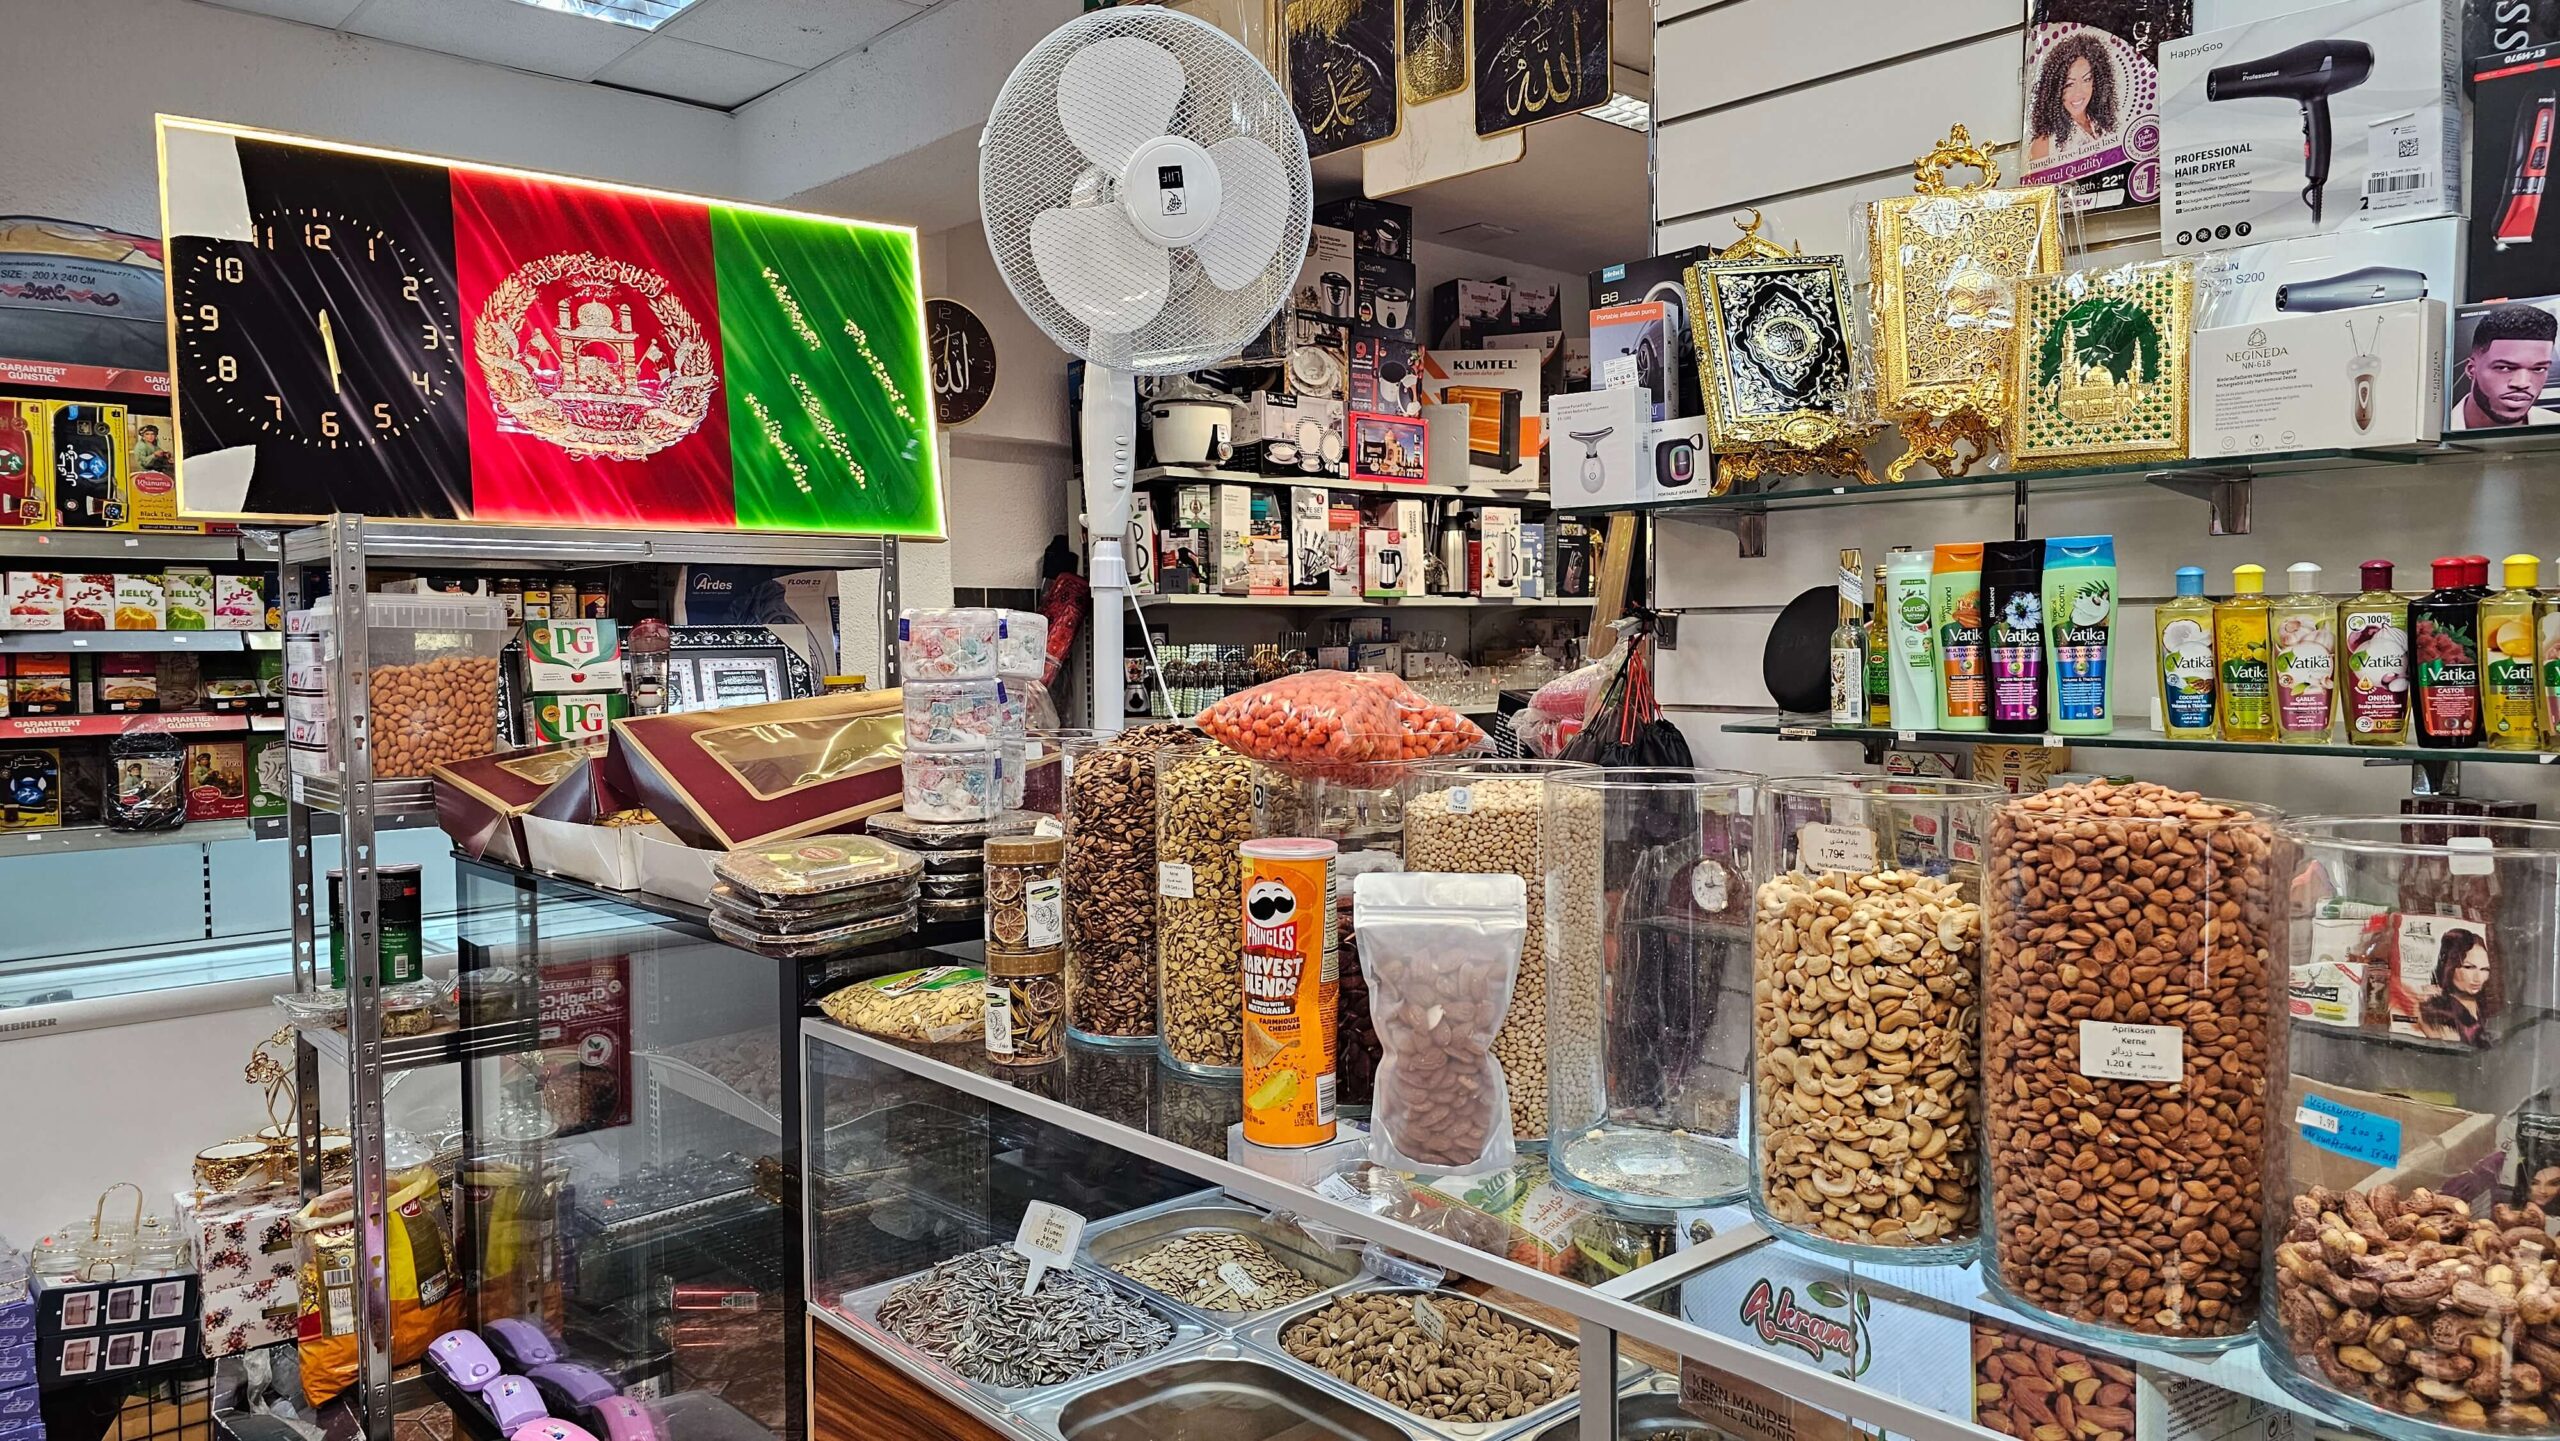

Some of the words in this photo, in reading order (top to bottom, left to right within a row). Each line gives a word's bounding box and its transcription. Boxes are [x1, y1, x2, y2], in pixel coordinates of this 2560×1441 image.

[2170, 42, 2223, 59] HappyGoo
[2242, 70, 2279, 81] Professional
[2029, 158, 2056, 170] Tangle
[2102, 134, 2120, 146] last
[2175, 143, 2253, 165] PROFESSIONAL
[2065, 156, 2103, 176] Quality
[2175, 165, 2199, 178] HAIR
[2202, 159, 2236, 173] DRYER
[305, 223, 331, 250] 12
[367, 237, 375, 261] 1
[32, 271, 50, 280] 200
[50, 272, 60, 281] X
[61, 274, 78, 283] 240
[80, 275, 96, 285] CM
[215, 256, 243, 284] 10
[2236, 271, 2265, 284] S200
[402, 275, 419, 302] 2
[199, 304, 219, 332] 9
[1597, 312, 1619, 321] Portable
[1641, 307, 1657, 317] pump
[423, 324, 439, 350] 3
[2226, 347, 2288, 363] NEGINEDA
[0, 363, 67, 376] GARANTIERT
[218, 355, 238, 382] 8
[412, 370, 430, 396] 4
[265, 395, 282, 421] 7
[374, 403, 392, 430] 5
[321, 411, 340, 437] 6
[695, 576, 733, 592] Ardes
[119, 589, 152, 598] JELLY
[169, 590, 201, 598] JELLY
[2367, 615, 2390, 624] 100%
[556, 627, 594, 654] PG
[1950, 628, 1983, 642] Vatik
[1997, 629, 2040, 643] Vatika
[2062, 628, 2106, 642] Vatika
[2172, 656, 2214, 669] Vatika
[2286, 656, 2330, 669] Vatika
[2358, 655, 2402, 668] Vatika
[2428, 667, 2476, 681] Vatika
[14, 719, 81, 728] GARANTIERT
[565, 704, 604, 733] PG
[1247, 922, 1294, 951] PRINGLES
[1245, 973, 1298, 997] BLENDS
[2112, 1025, 2156, 1035] Aprikosen
[2121, 1037, 2147, 1045] Kerne
[2105, 1059, 2124, 1068] 1.20
[1743, 1283, 1851, 1357] Akram
[1692, 1374, 1728, 1402] KERN
[1732, 1392, 1796, 1434] MANDEL
[1692, 1390, 1738, 1421] KERNEL
[1740, 1412, 1796, 1441] ALMOND
